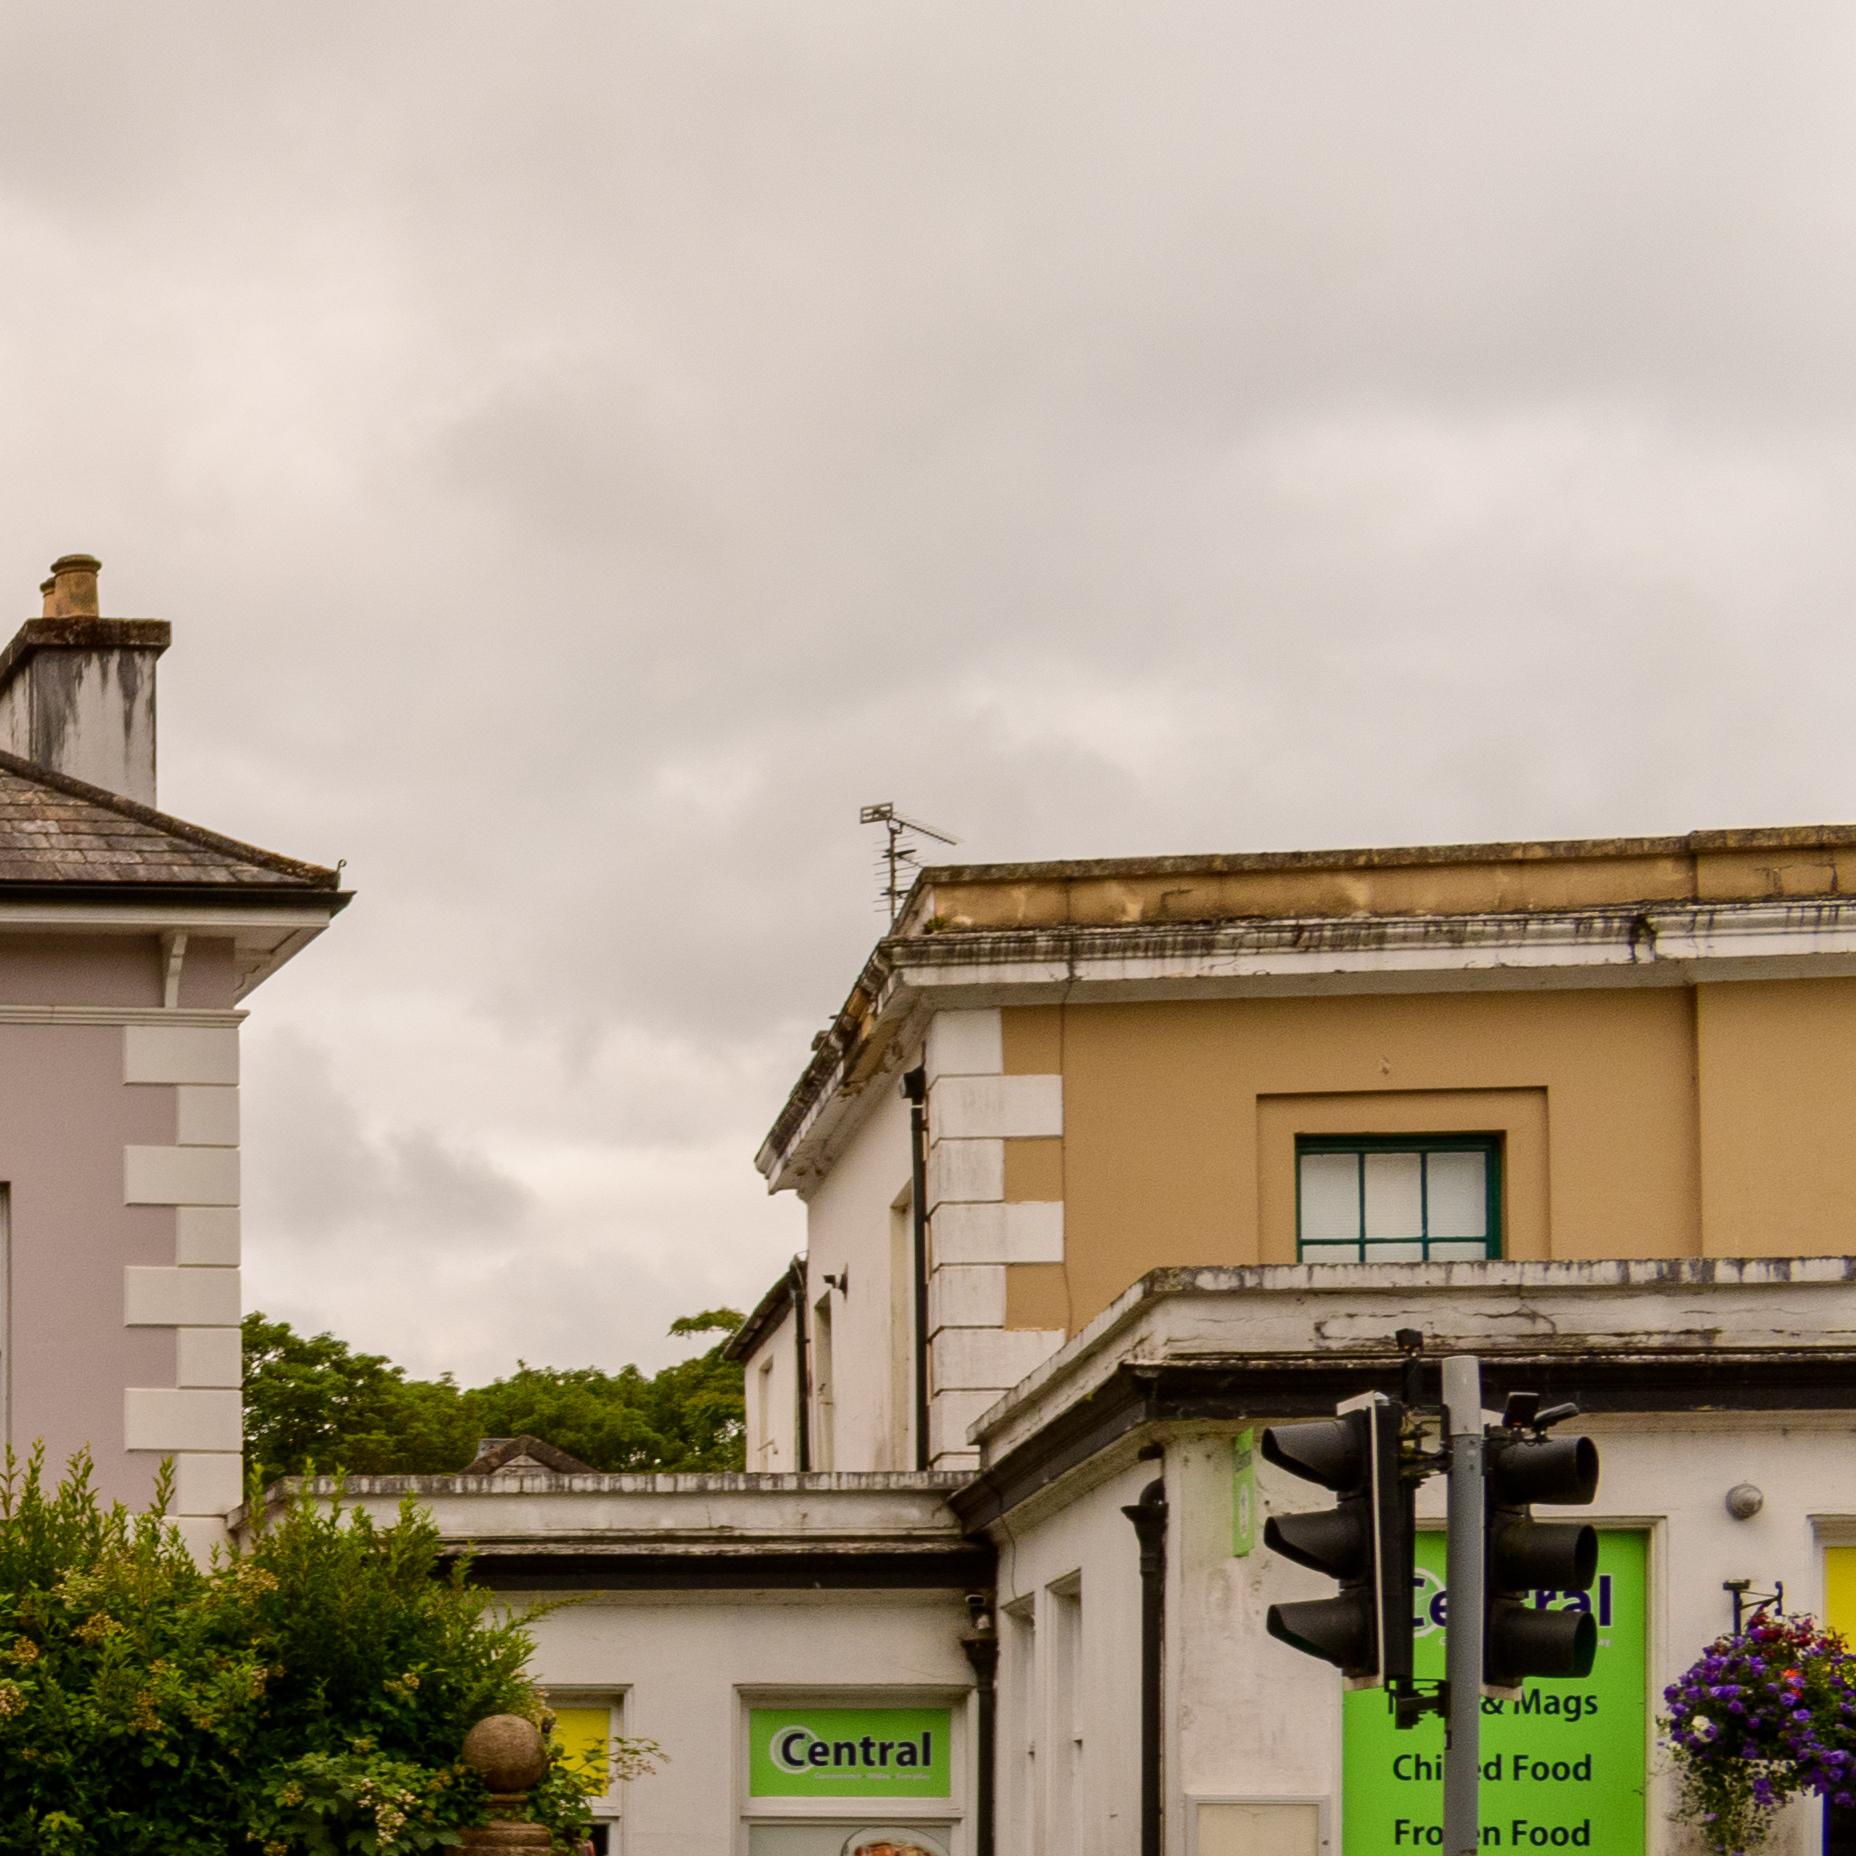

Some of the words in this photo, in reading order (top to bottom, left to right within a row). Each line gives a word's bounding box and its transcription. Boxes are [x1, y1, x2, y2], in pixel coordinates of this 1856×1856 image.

[1480, 1692, 1504, 1715] &
[1513, 1688, 1598, 1722] Mags
[781, 1731, 931, 1767] Central
[1513, 1753, 1592, 1782] Food
[1511, 1819, 1591, 1847] Food
